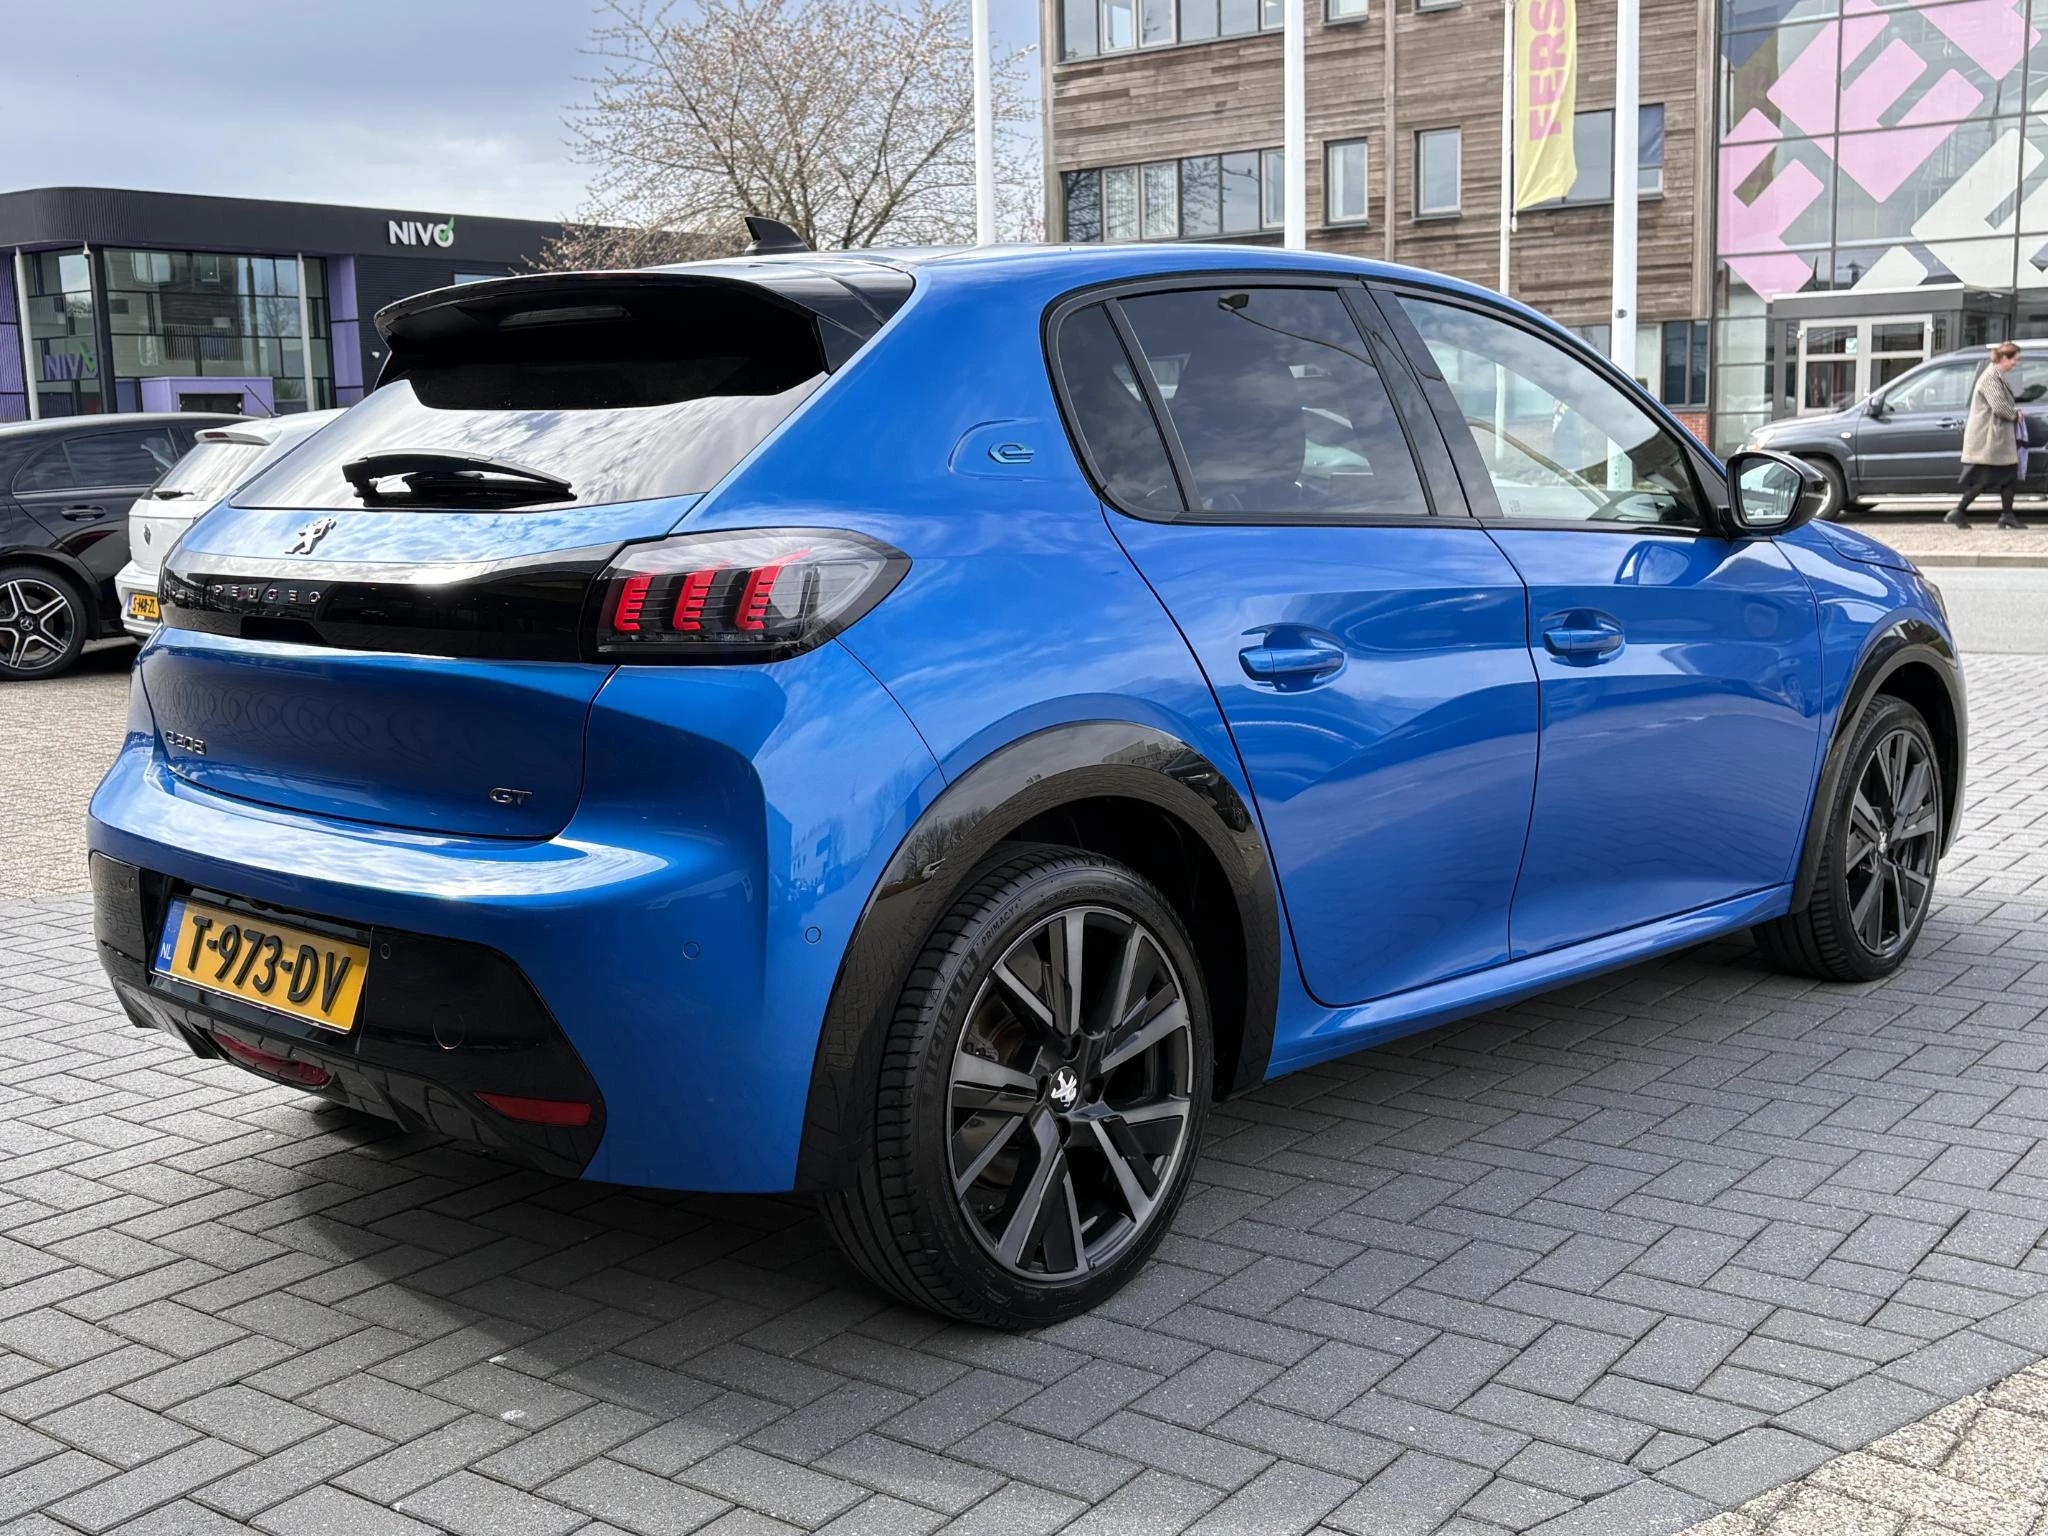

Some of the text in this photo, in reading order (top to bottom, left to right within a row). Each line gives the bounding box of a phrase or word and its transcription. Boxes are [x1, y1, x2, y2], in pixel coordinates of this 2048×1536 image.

[1529, 0, 1567, 141] FERS
[388, 217, 455, 248] NIVO
[213, 584, 321, 603] PEUGEO
[489, 787, 533, 806] GT
[981, 904, 1015, 946] PRIMACY
[159, 942, 172, 961] NL
[187, 915, 352, 1015] T-973-DV
[925, 950, 978, 1080] ICHELIN
